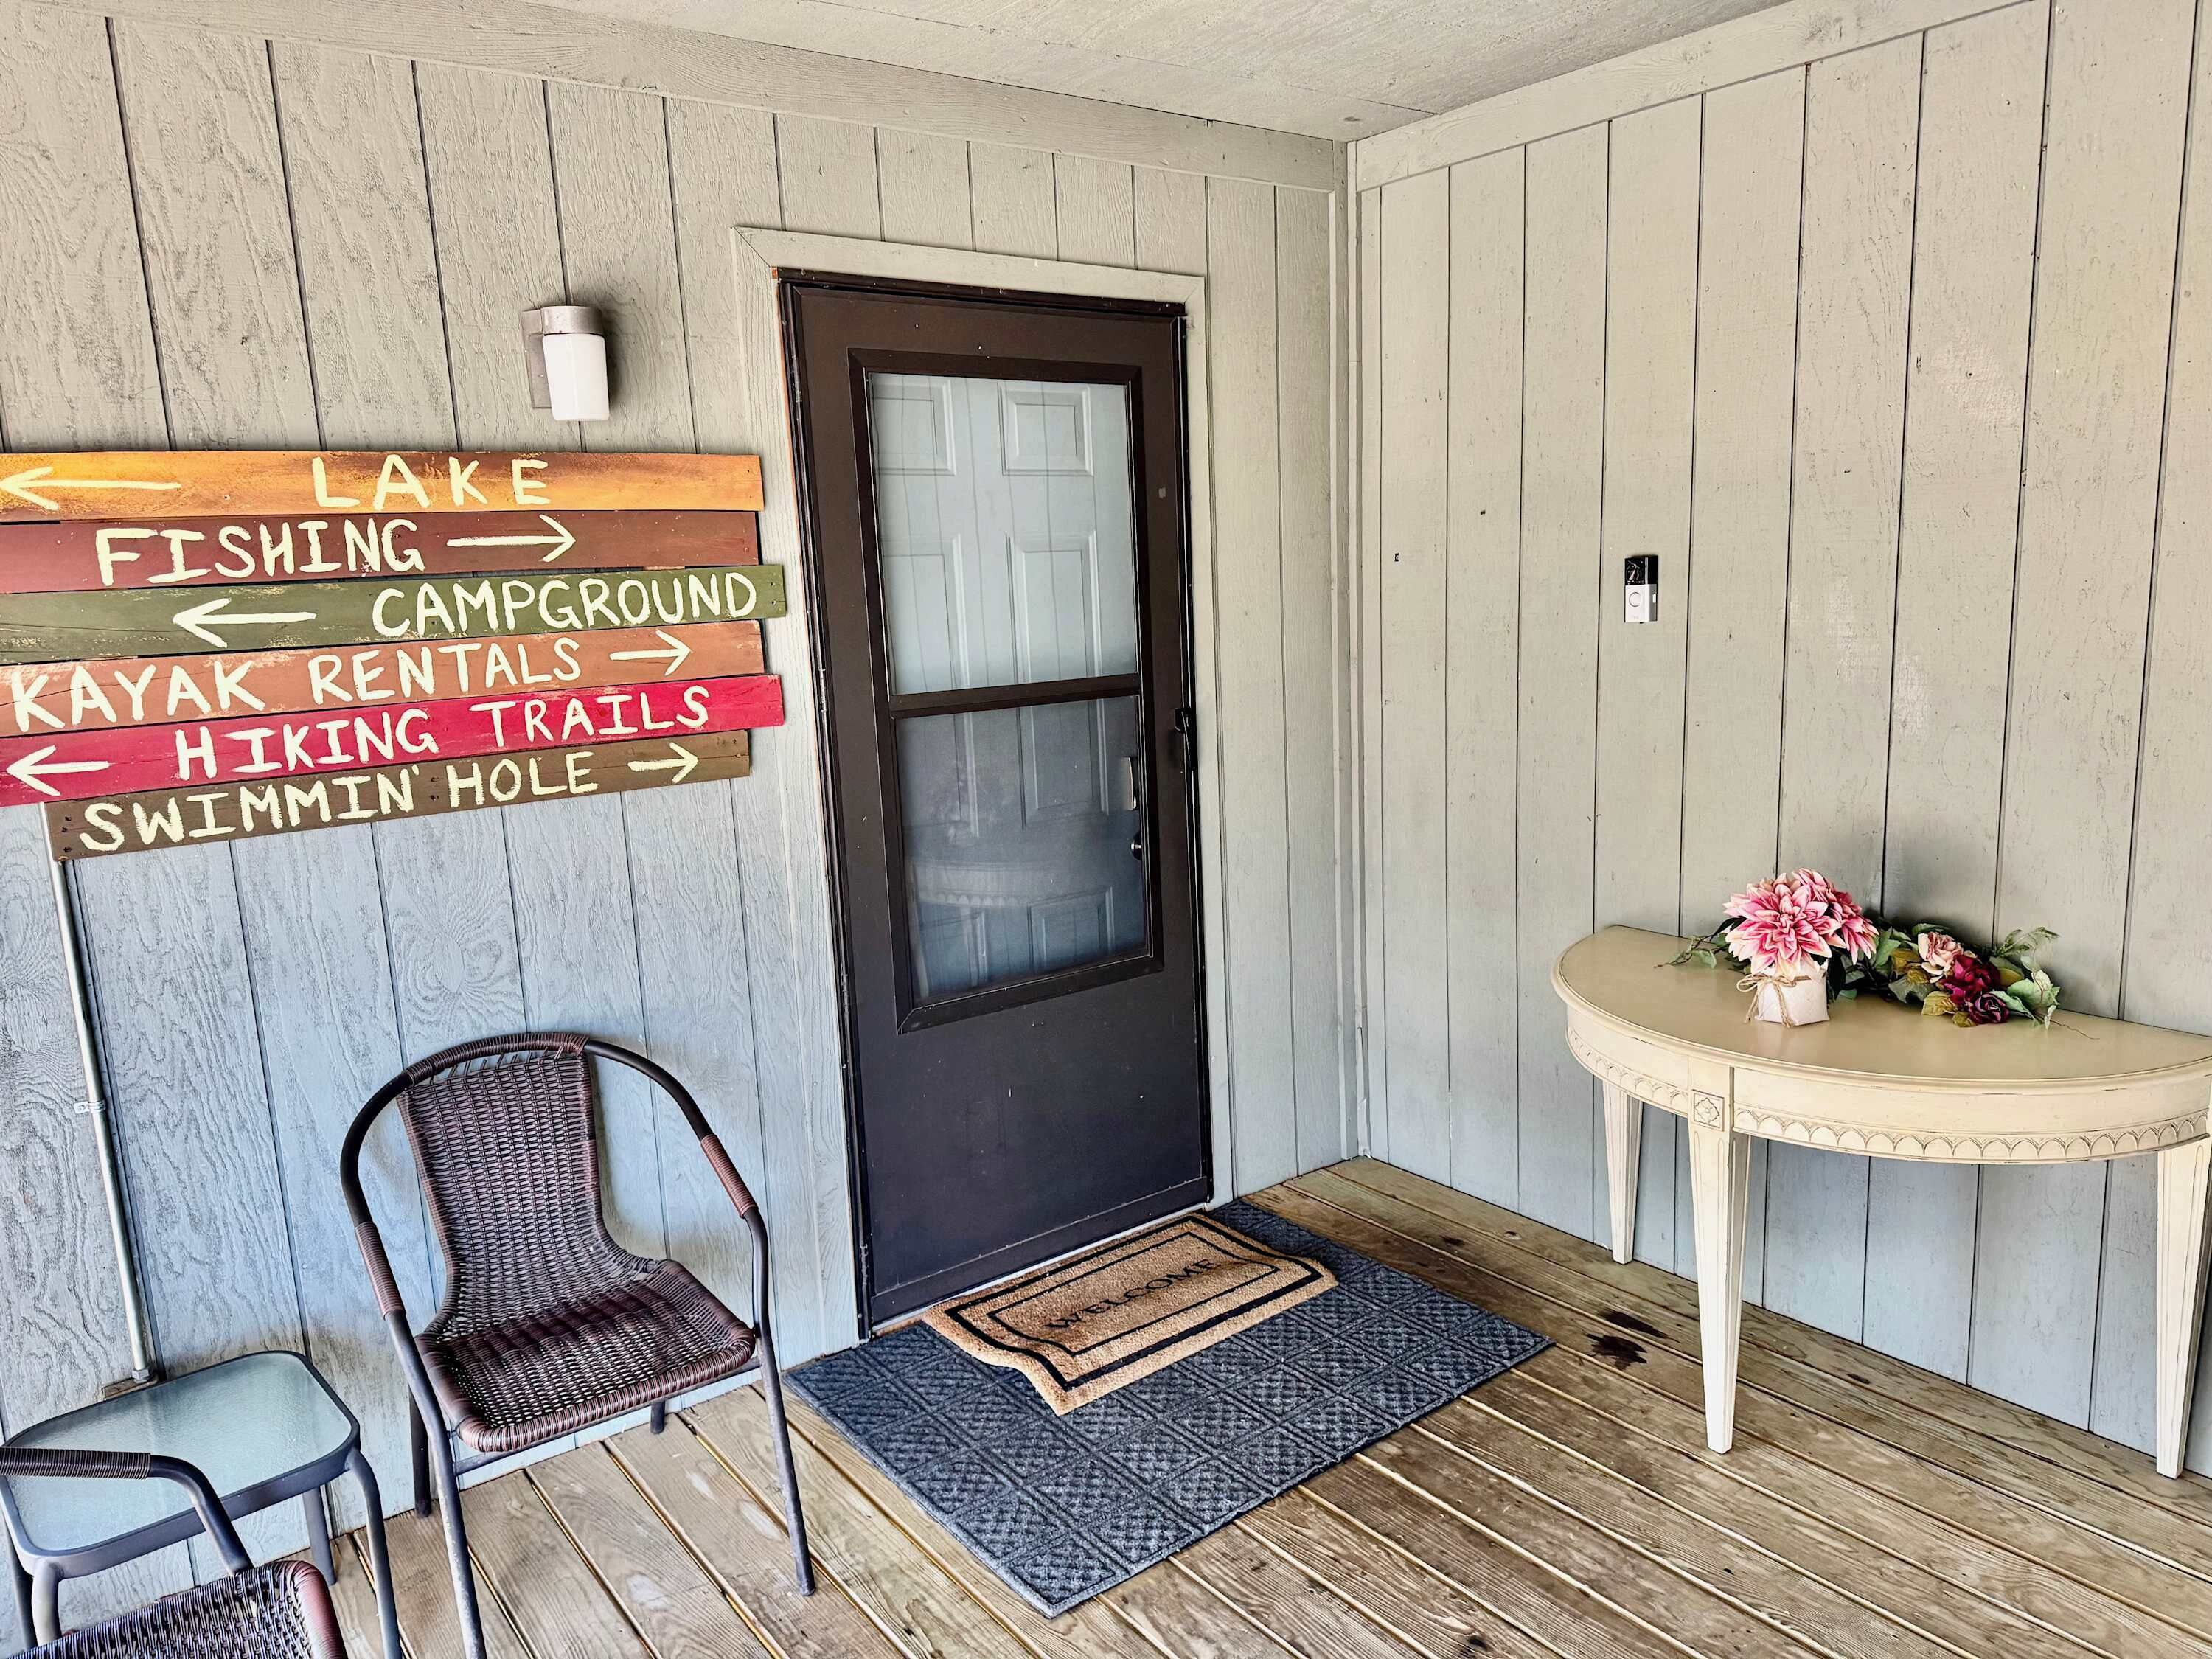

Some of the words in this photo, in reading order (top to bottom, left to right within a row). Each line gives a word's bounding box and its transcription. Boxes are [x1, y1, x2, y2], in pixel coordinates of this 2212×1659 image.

[312, 454, 551, 510] LAKE
[95, 518, 425, 586] FISHING
[372, 572, 757, 637] CAMPGROUND
[10, 659, 265, 732] KAYAK
[307, 637, 582, 705] RENTALS
[175, 708, 439, 781] HIKING
[469, 685, 710, 747] TRAILS
[79, 764, 420, 852] SWIMMIN'
[446, 751, 599, 809] HOLE
[1044, 1258, 1217, 1328] WELCOME
